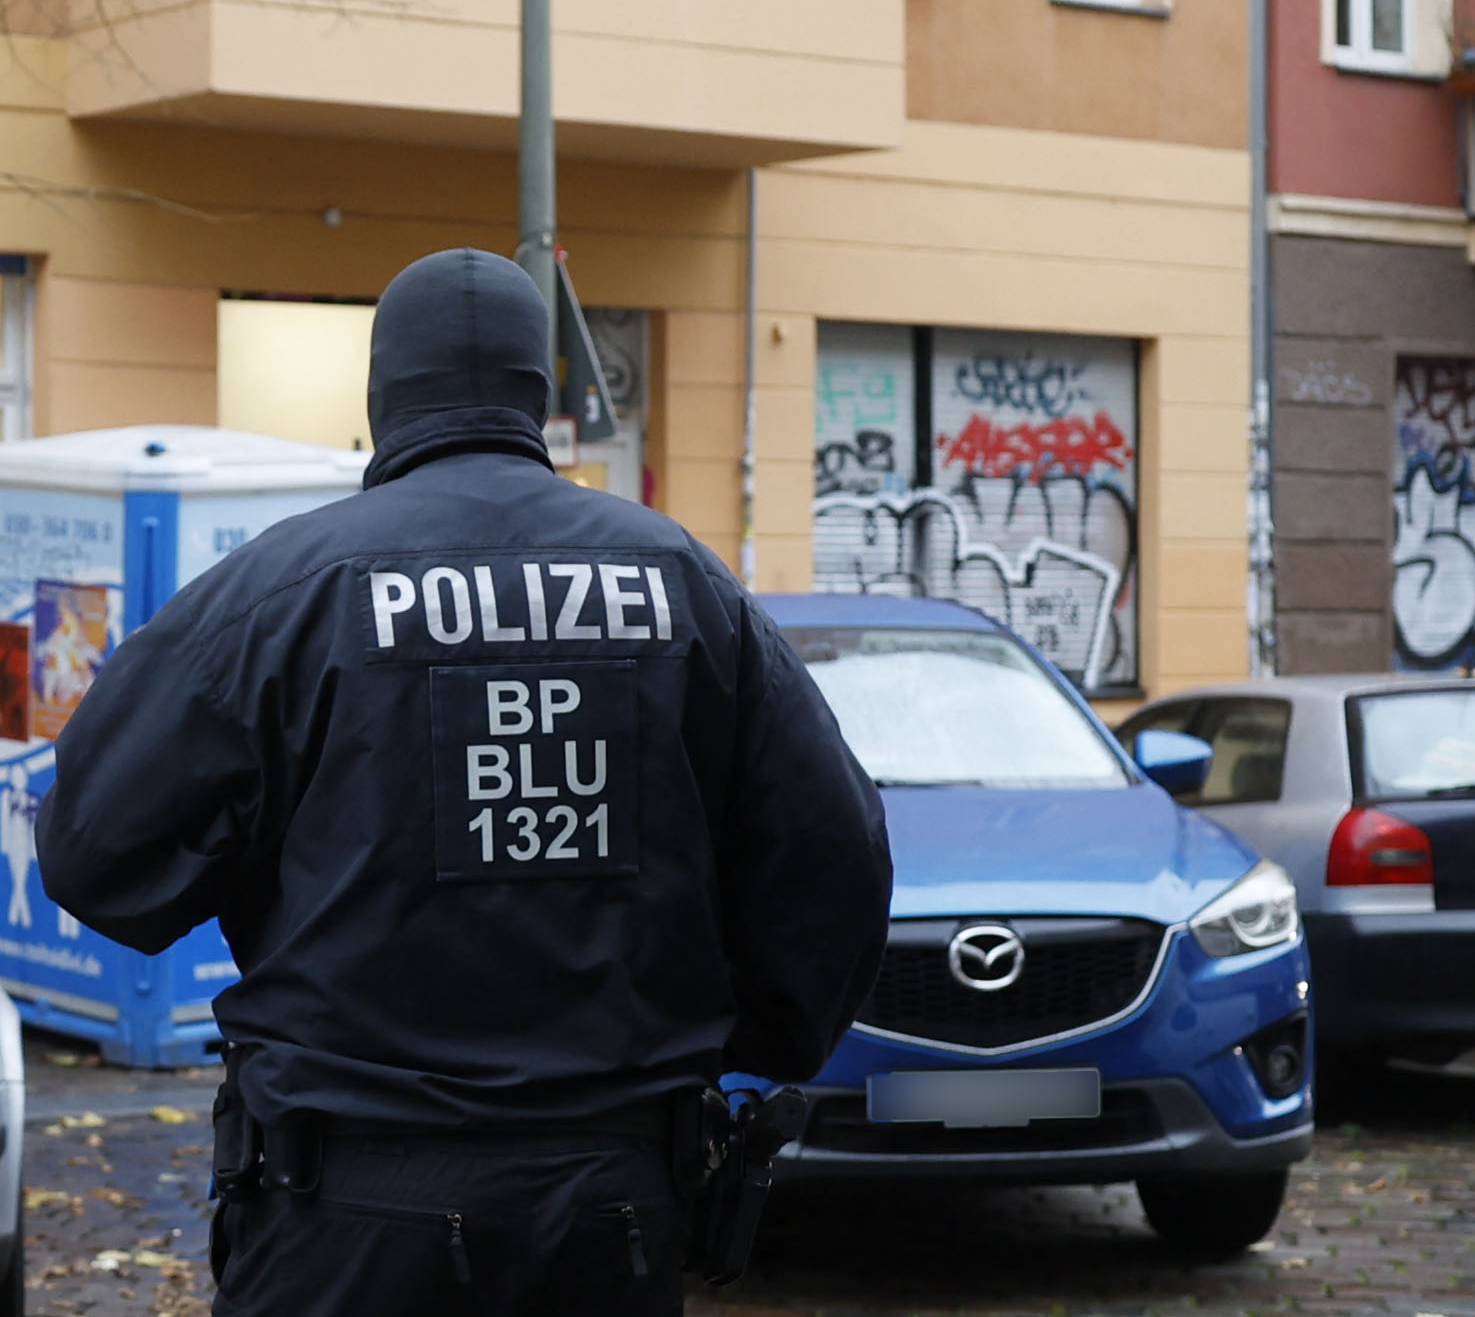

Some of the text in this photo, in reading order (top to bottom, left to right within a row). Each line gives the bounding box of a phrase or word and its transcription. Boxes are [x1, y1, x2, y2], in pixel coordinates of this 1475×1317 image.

[369, 562, 674, 649] POLIZEI
[486, 679, 582, 737] BP
[467, 738, 609, 801] BLU
[468, 802, 610, 863] 1321
